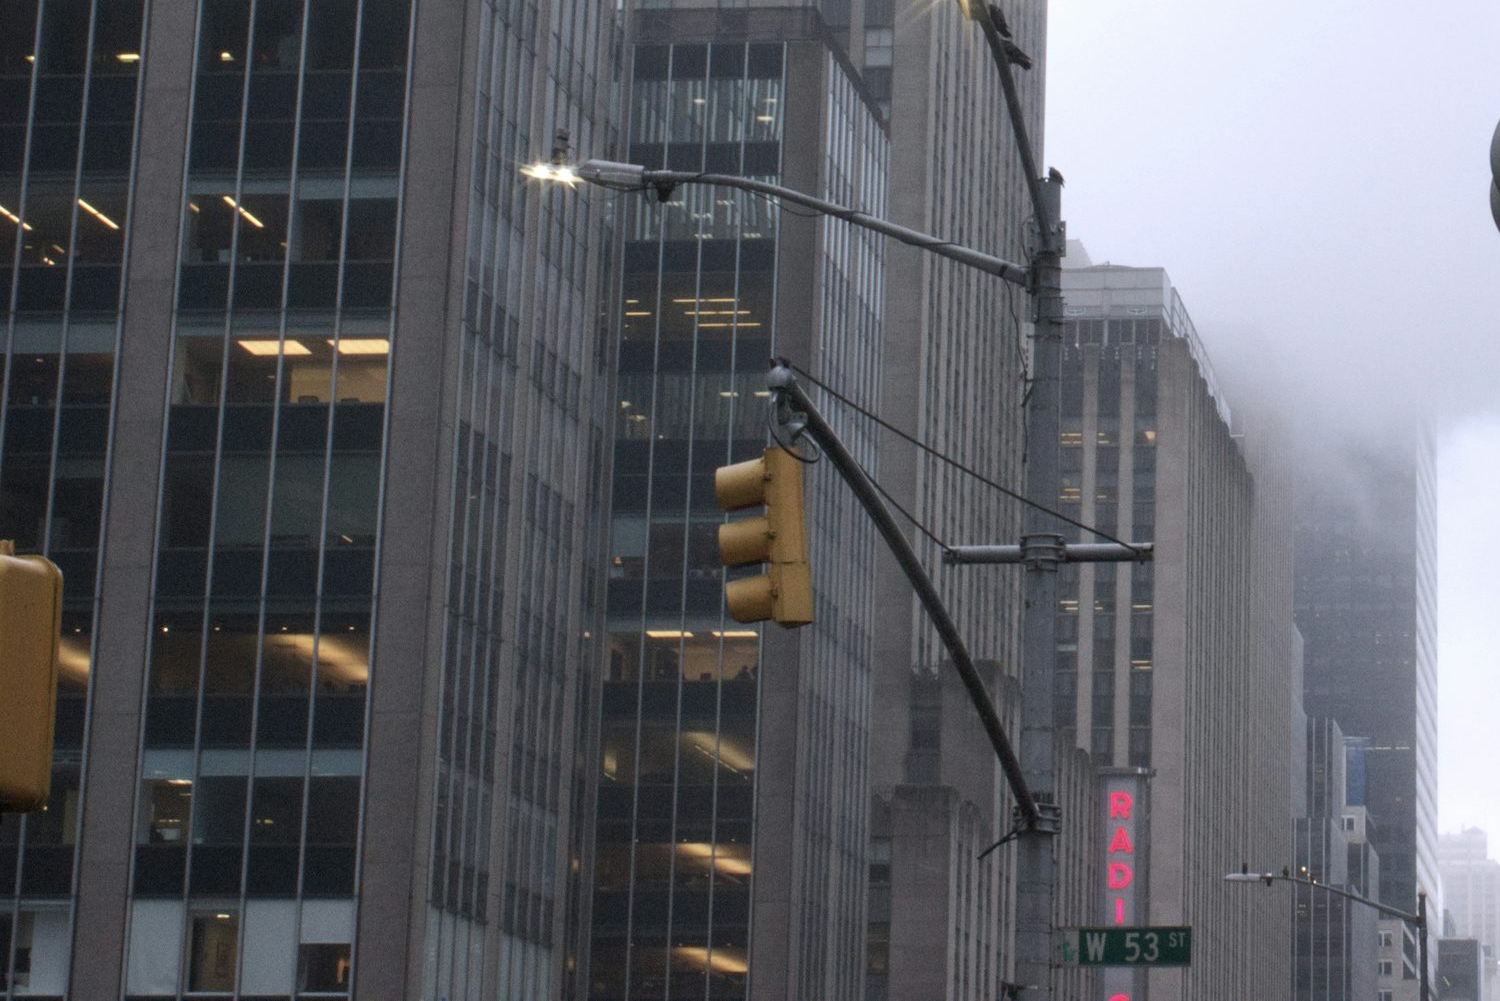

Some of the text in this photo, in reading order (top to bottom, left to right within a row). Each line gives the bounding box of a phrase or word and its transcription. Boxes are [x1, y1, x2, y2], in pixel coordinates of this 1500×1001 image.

[1107, 791, 1134, 925] RADI
[1086, 932, 1186, 962] W 53 ST
